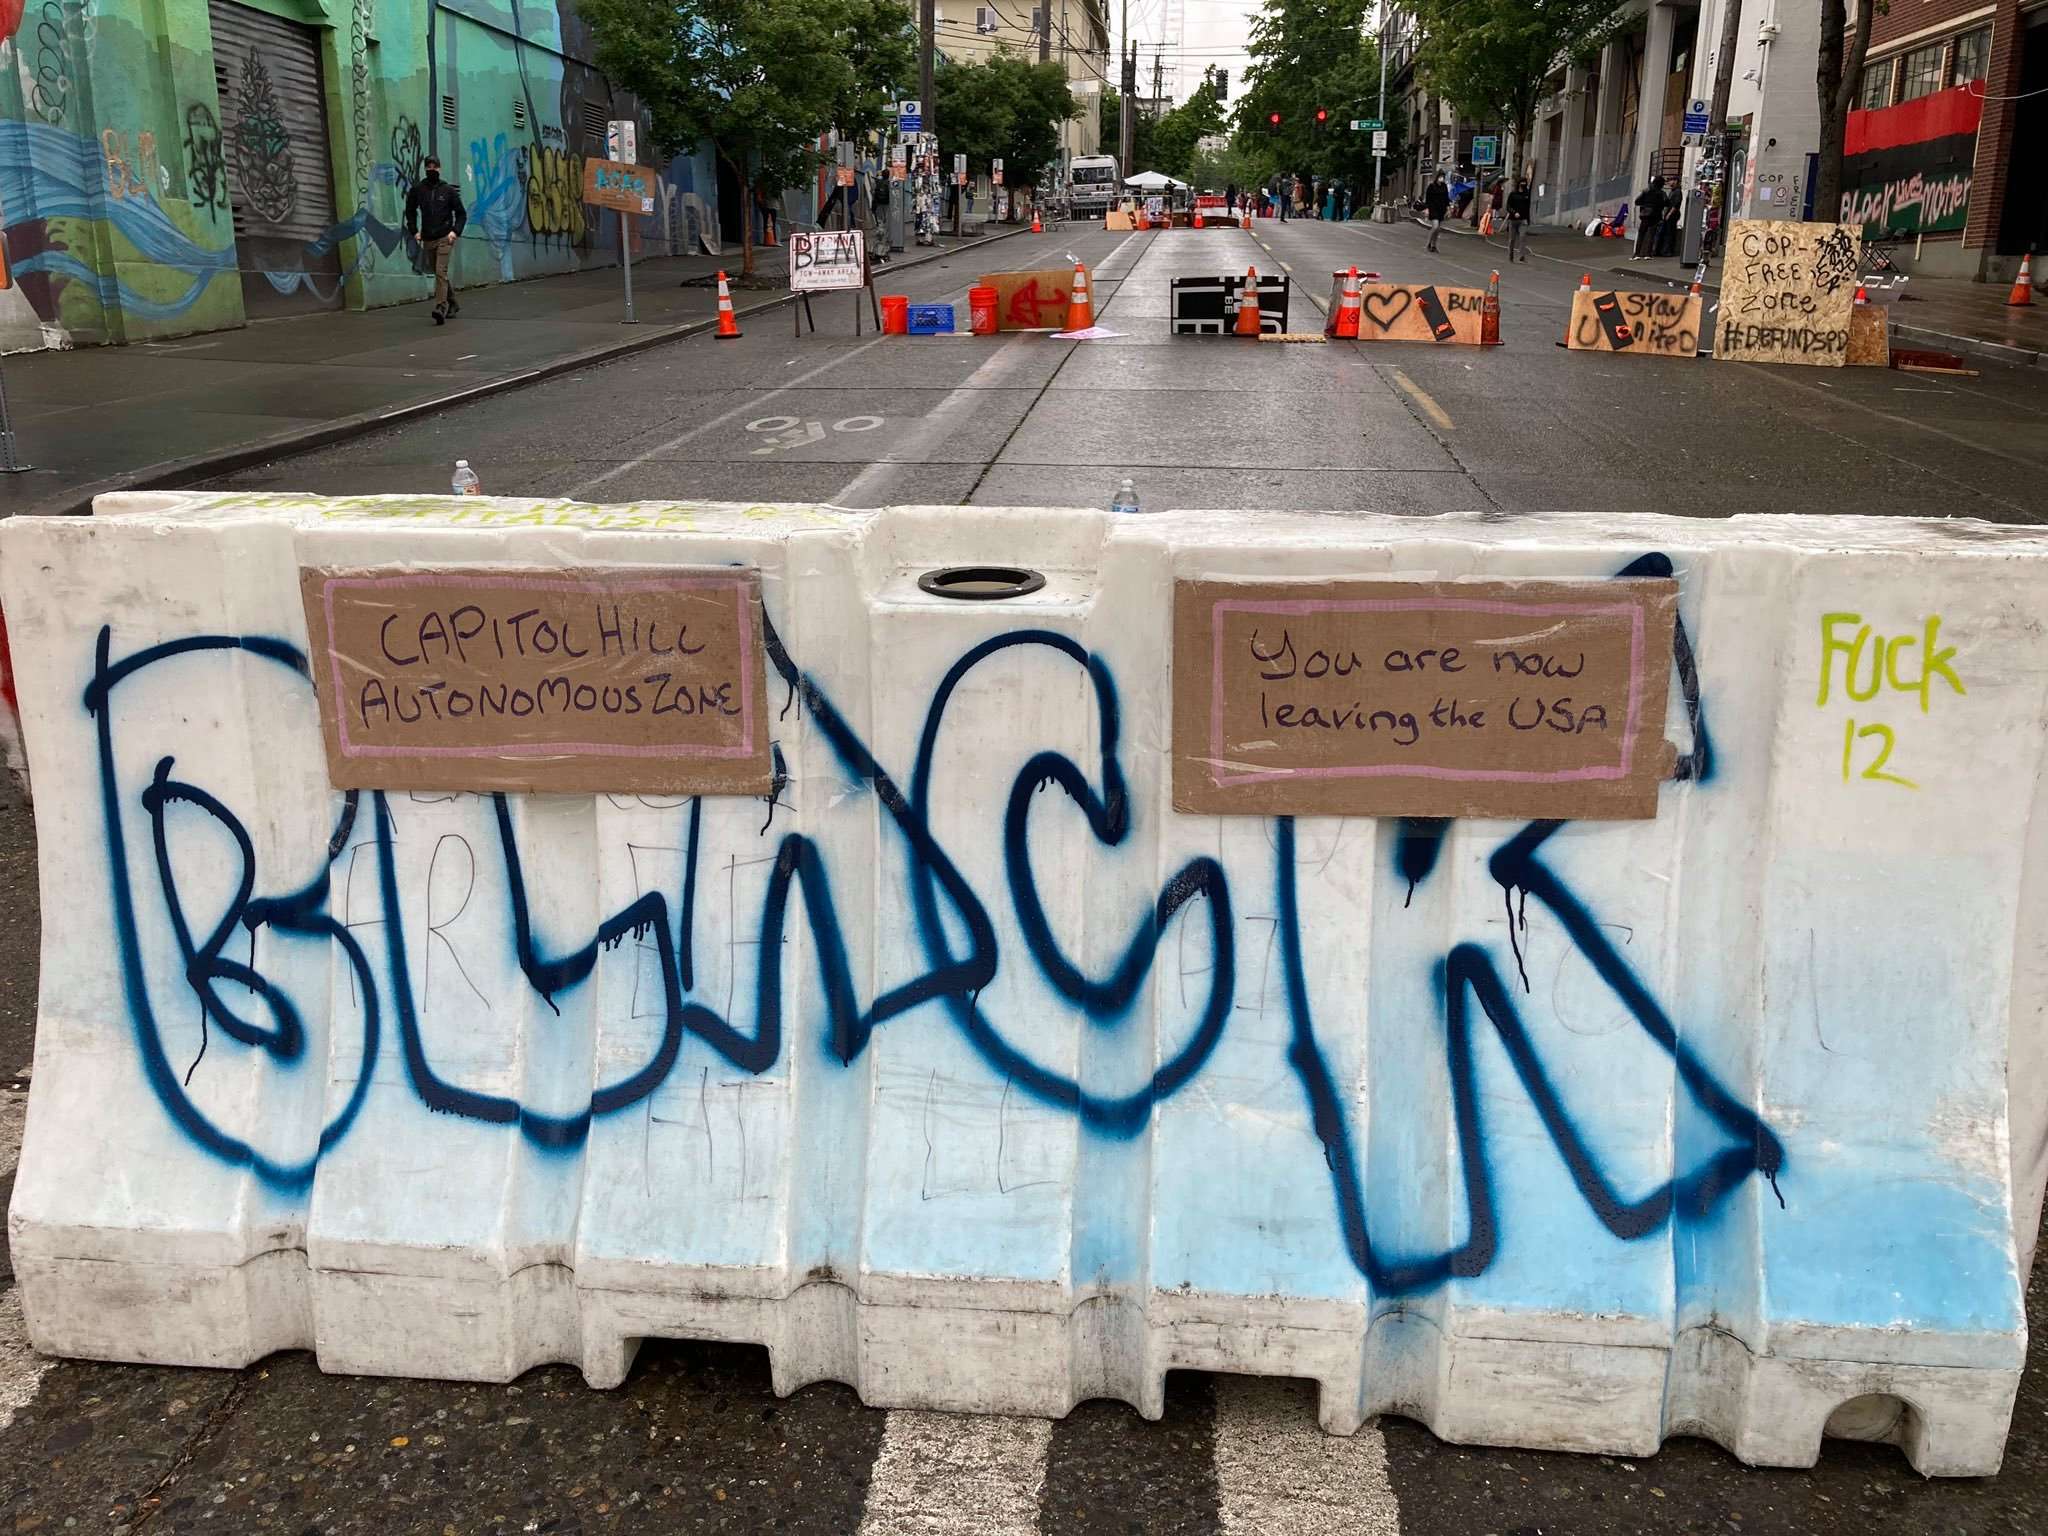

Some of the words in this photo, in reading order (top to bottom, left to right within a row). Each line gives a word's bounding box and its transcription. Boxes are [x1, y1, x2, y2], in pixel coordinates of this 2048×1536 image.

[1758, 174, 1784, 182] COP
[794, 232, 860, 271] BLM
[1745, 261, 1801, 284] FREE
[1448, 293, 1482, 316] BLM
[380, 604, 588, 666] CAPITOL
[596, 604, 706, 658] HILL
[1249, 627, 1363, 681] You
[1383, 646, 1468, 674] are
[1493, 649, 1585, 680] now
[360, 676, 642, 729] AUTONOMOUS
[644, 673, 743, 716] ZONE
[1260, 691, 1421, 746] leaving
[1427, 698, 1486, 730] the
[1508, 697, 1609, 735] USA
[1841, 718, 1921, 792] 12
[84, 553, 1786, 1302] BLACK
